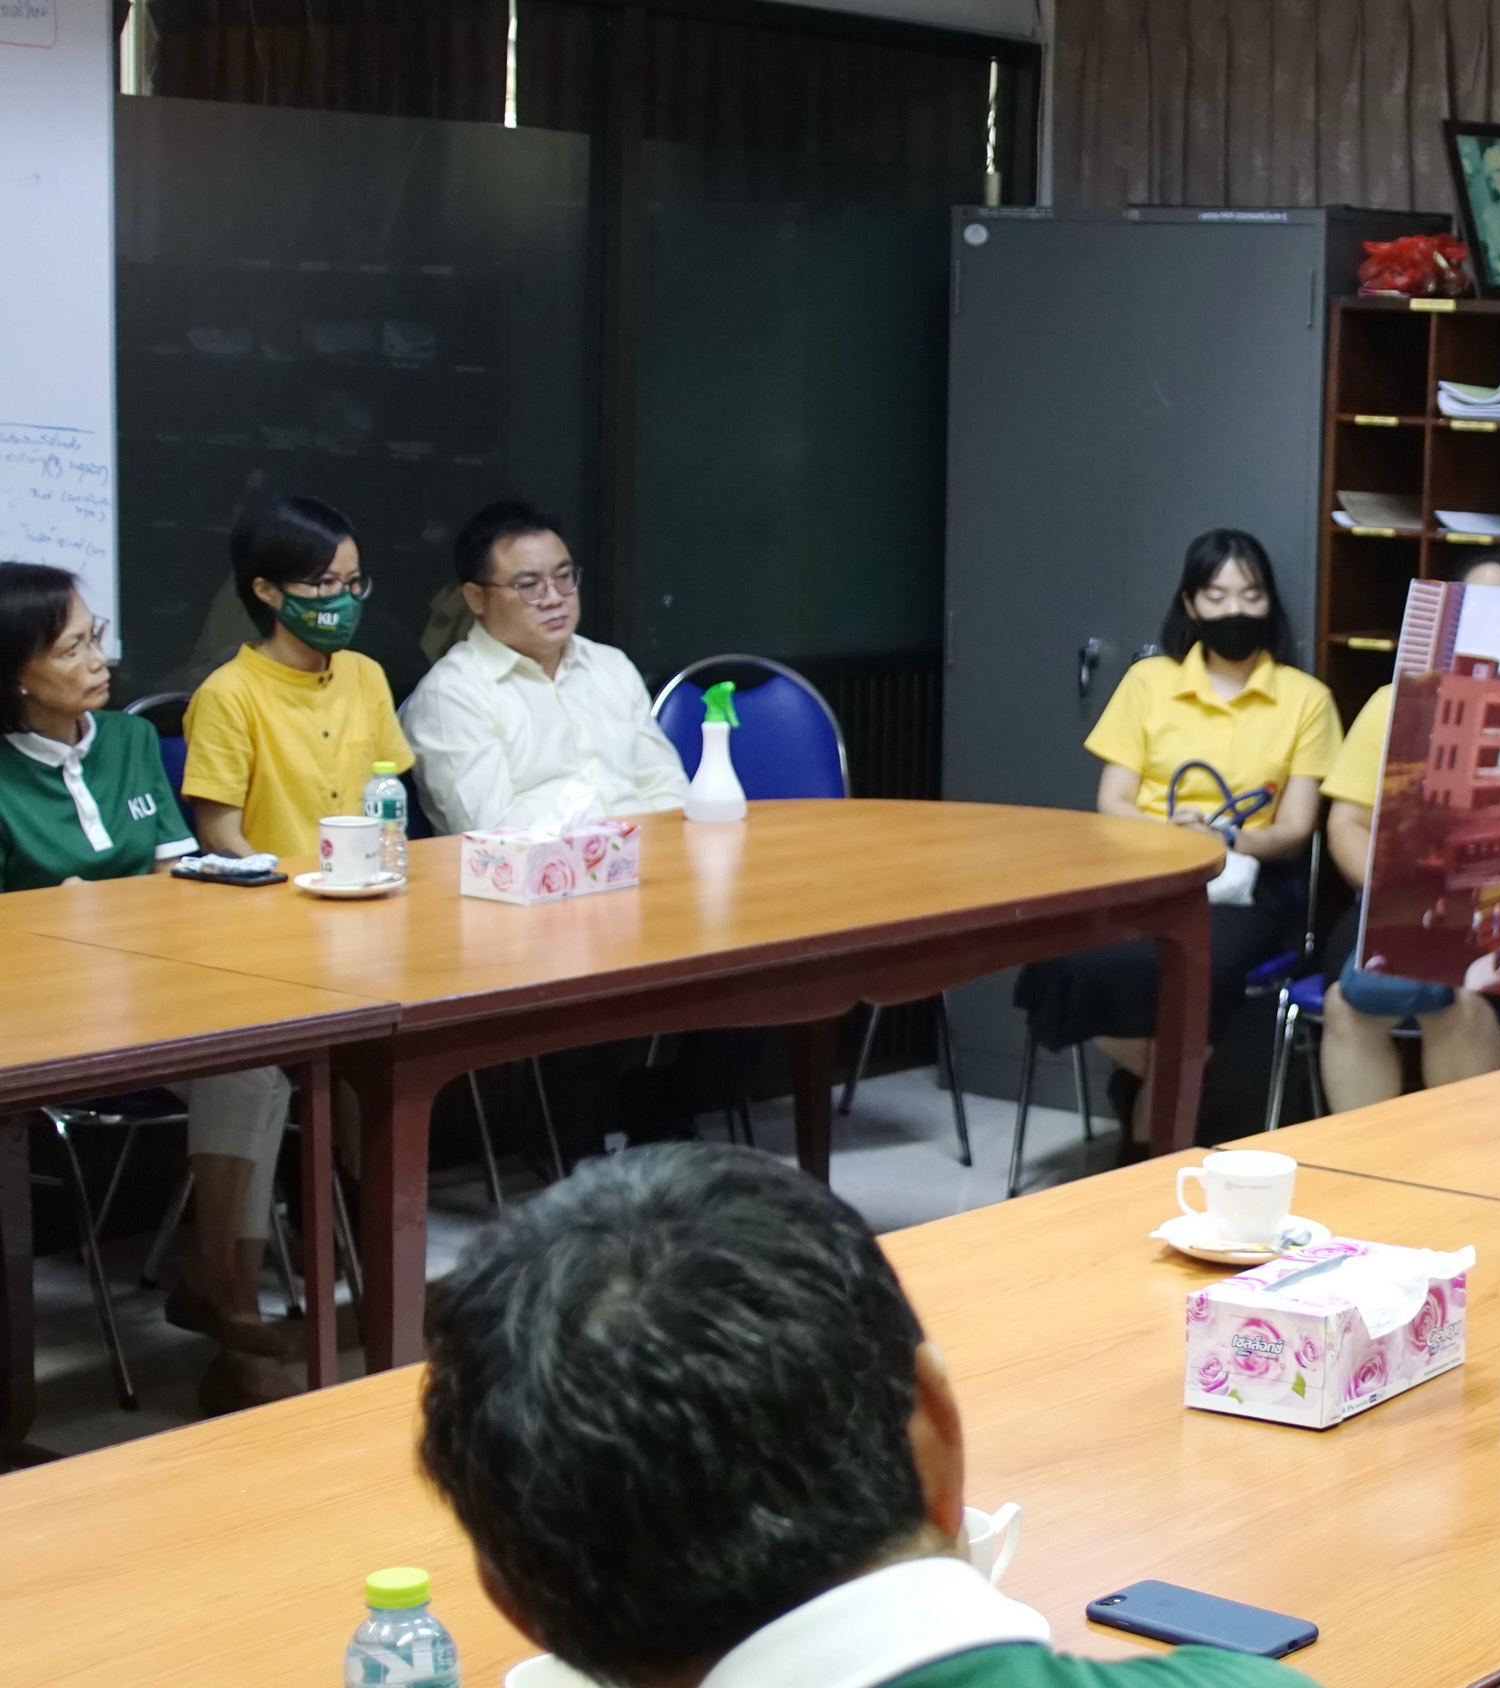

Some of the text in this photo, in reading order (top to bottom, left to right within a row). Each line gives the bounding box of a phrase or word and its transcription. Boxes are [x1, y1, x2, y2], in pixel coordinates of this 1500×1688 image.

[317, 611, 340, 626] KU
[127, 793, 157, 821] KU
[320, 862, 333, 873] LG
